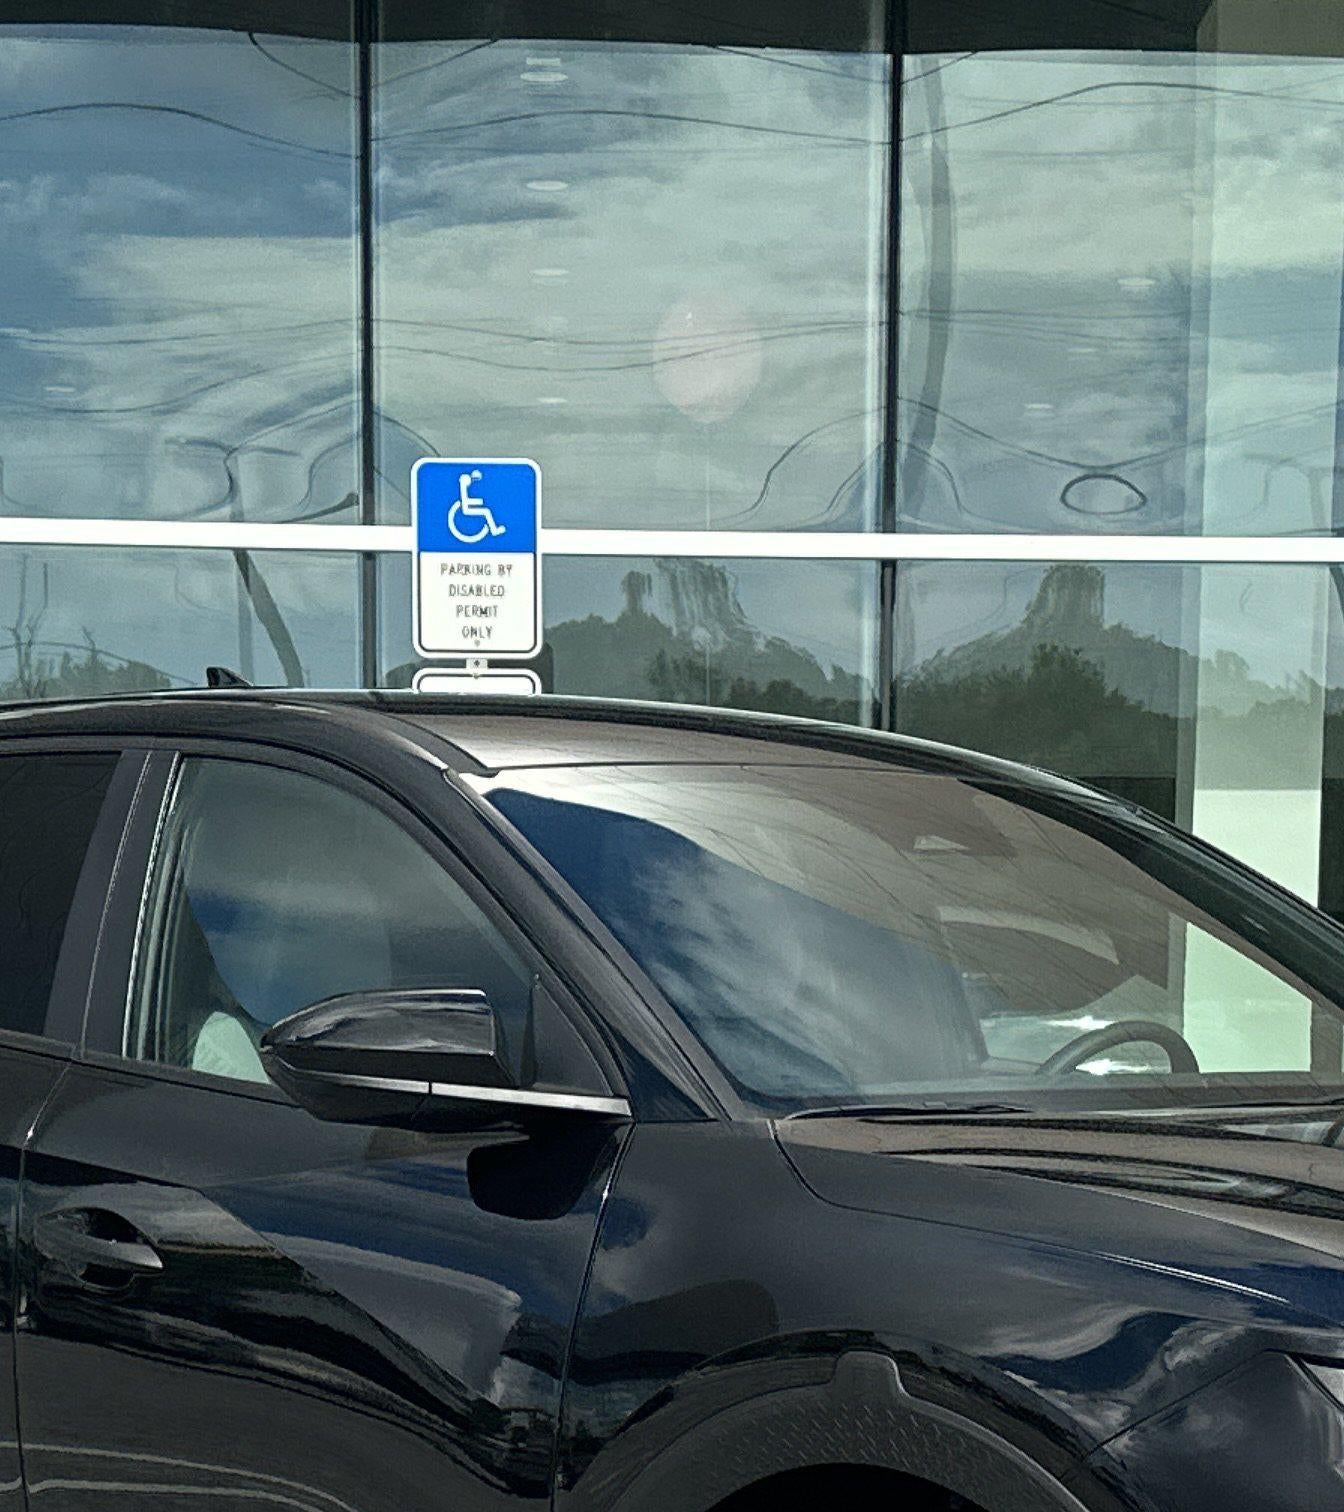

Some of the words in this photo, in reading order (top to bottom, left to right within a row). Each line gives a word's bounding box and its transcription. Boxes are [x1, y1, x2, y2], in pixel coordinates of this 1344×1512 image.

[440, 562, 491, 576] PARKING
[497, 562, 513, 576] BY
[448, 583, 505, 597] DISABLED
[455, 604, 498, 618] PERMIT
[462, 626, 493, 639] ONLY
